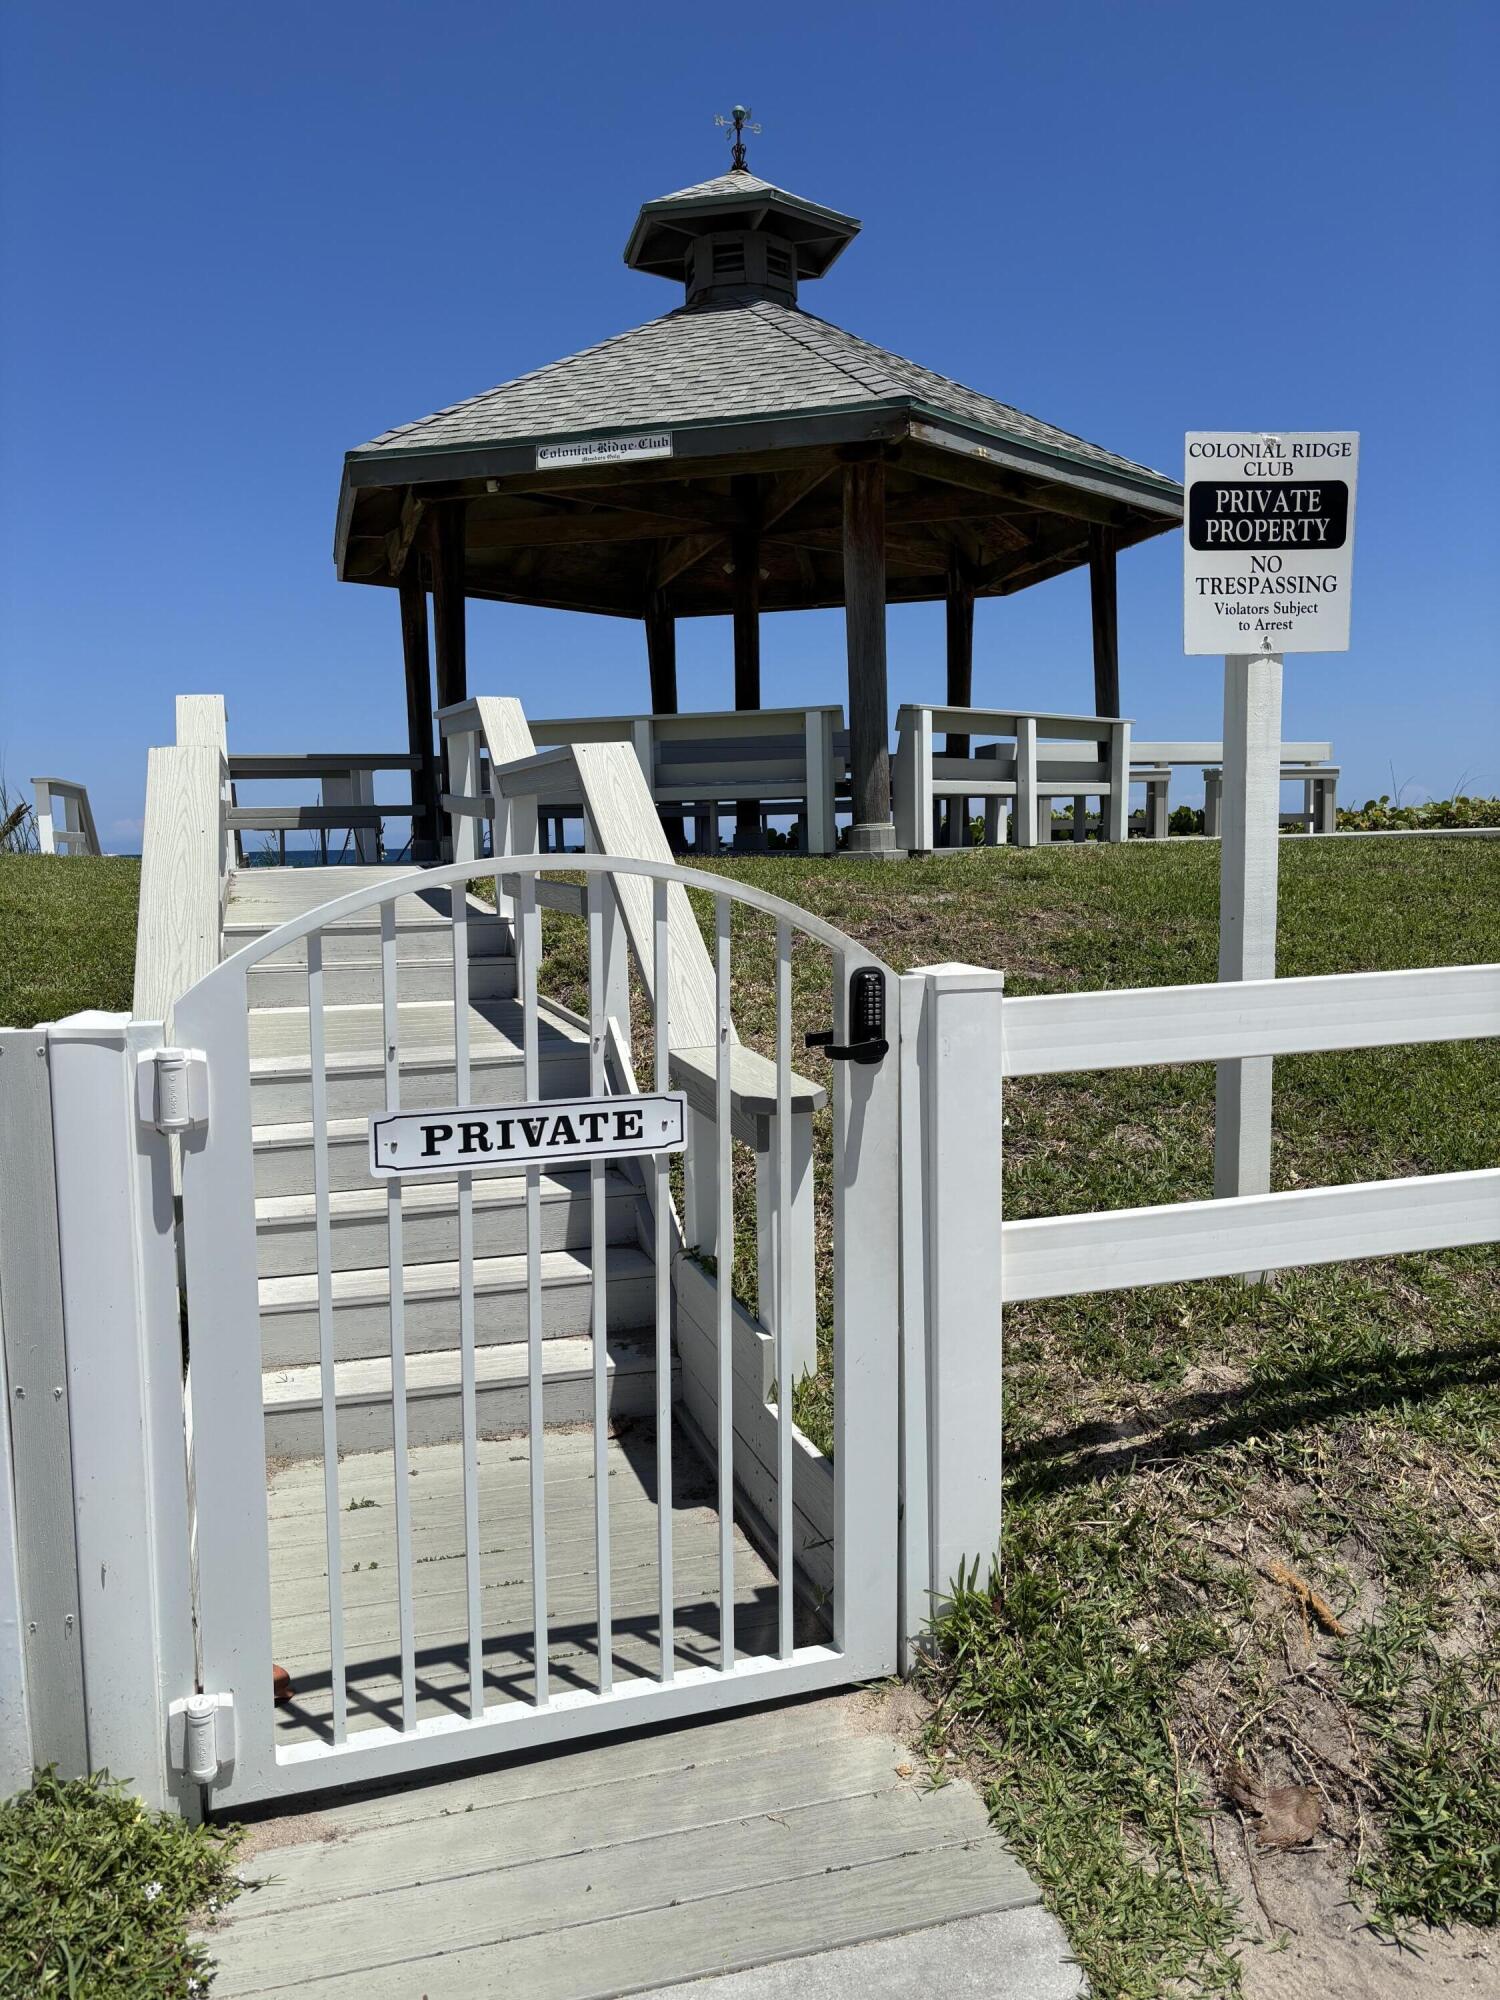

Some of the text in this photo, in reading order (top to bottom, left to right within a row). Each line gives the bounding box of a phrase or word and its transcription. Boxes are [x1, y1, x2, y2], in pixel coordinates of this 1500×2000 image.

[1189, 442, 1352, 458] COLONIAL RIDGE
[1243, 462, 1294, 476] CLUB
[1215, 489, 1322, 513] PRIVATE
[1205, 518, 1330, 543] PROPERTY
[1250, 555, 1283, 573] NO
[1195, 575, 1337, 595] TRESPASSING
[1214, 601, 1319, 617] Violators Subject
[1238, 618, 1294, 631] to Arrest
[420, 1109, 643, 1157] PRIVATE
